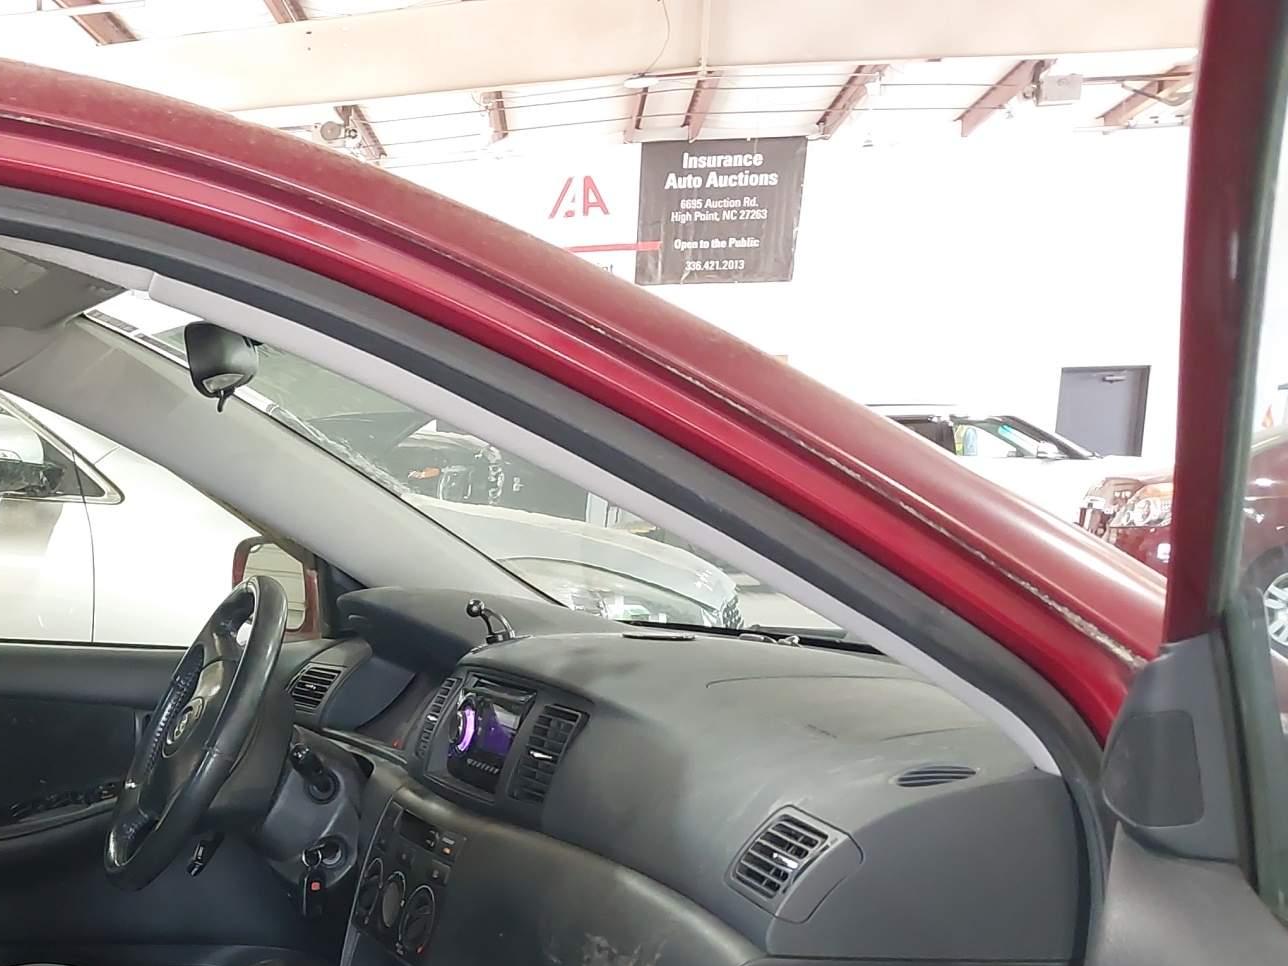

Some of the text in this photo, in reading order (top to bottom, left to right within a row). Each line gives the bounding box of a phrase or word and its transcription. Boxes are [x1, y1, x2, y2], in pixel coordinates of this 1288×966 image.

[682, 152, 764, 169] Insurance
[664, 170, 779, 190] Auto Auctions
[704, 197, 741, 209] Auction
[743, 196, 759, 208] Rd.
[671, 208, 768, 224] High Point, NC 27263
[674, 237, 760, 251] Open to the Public
